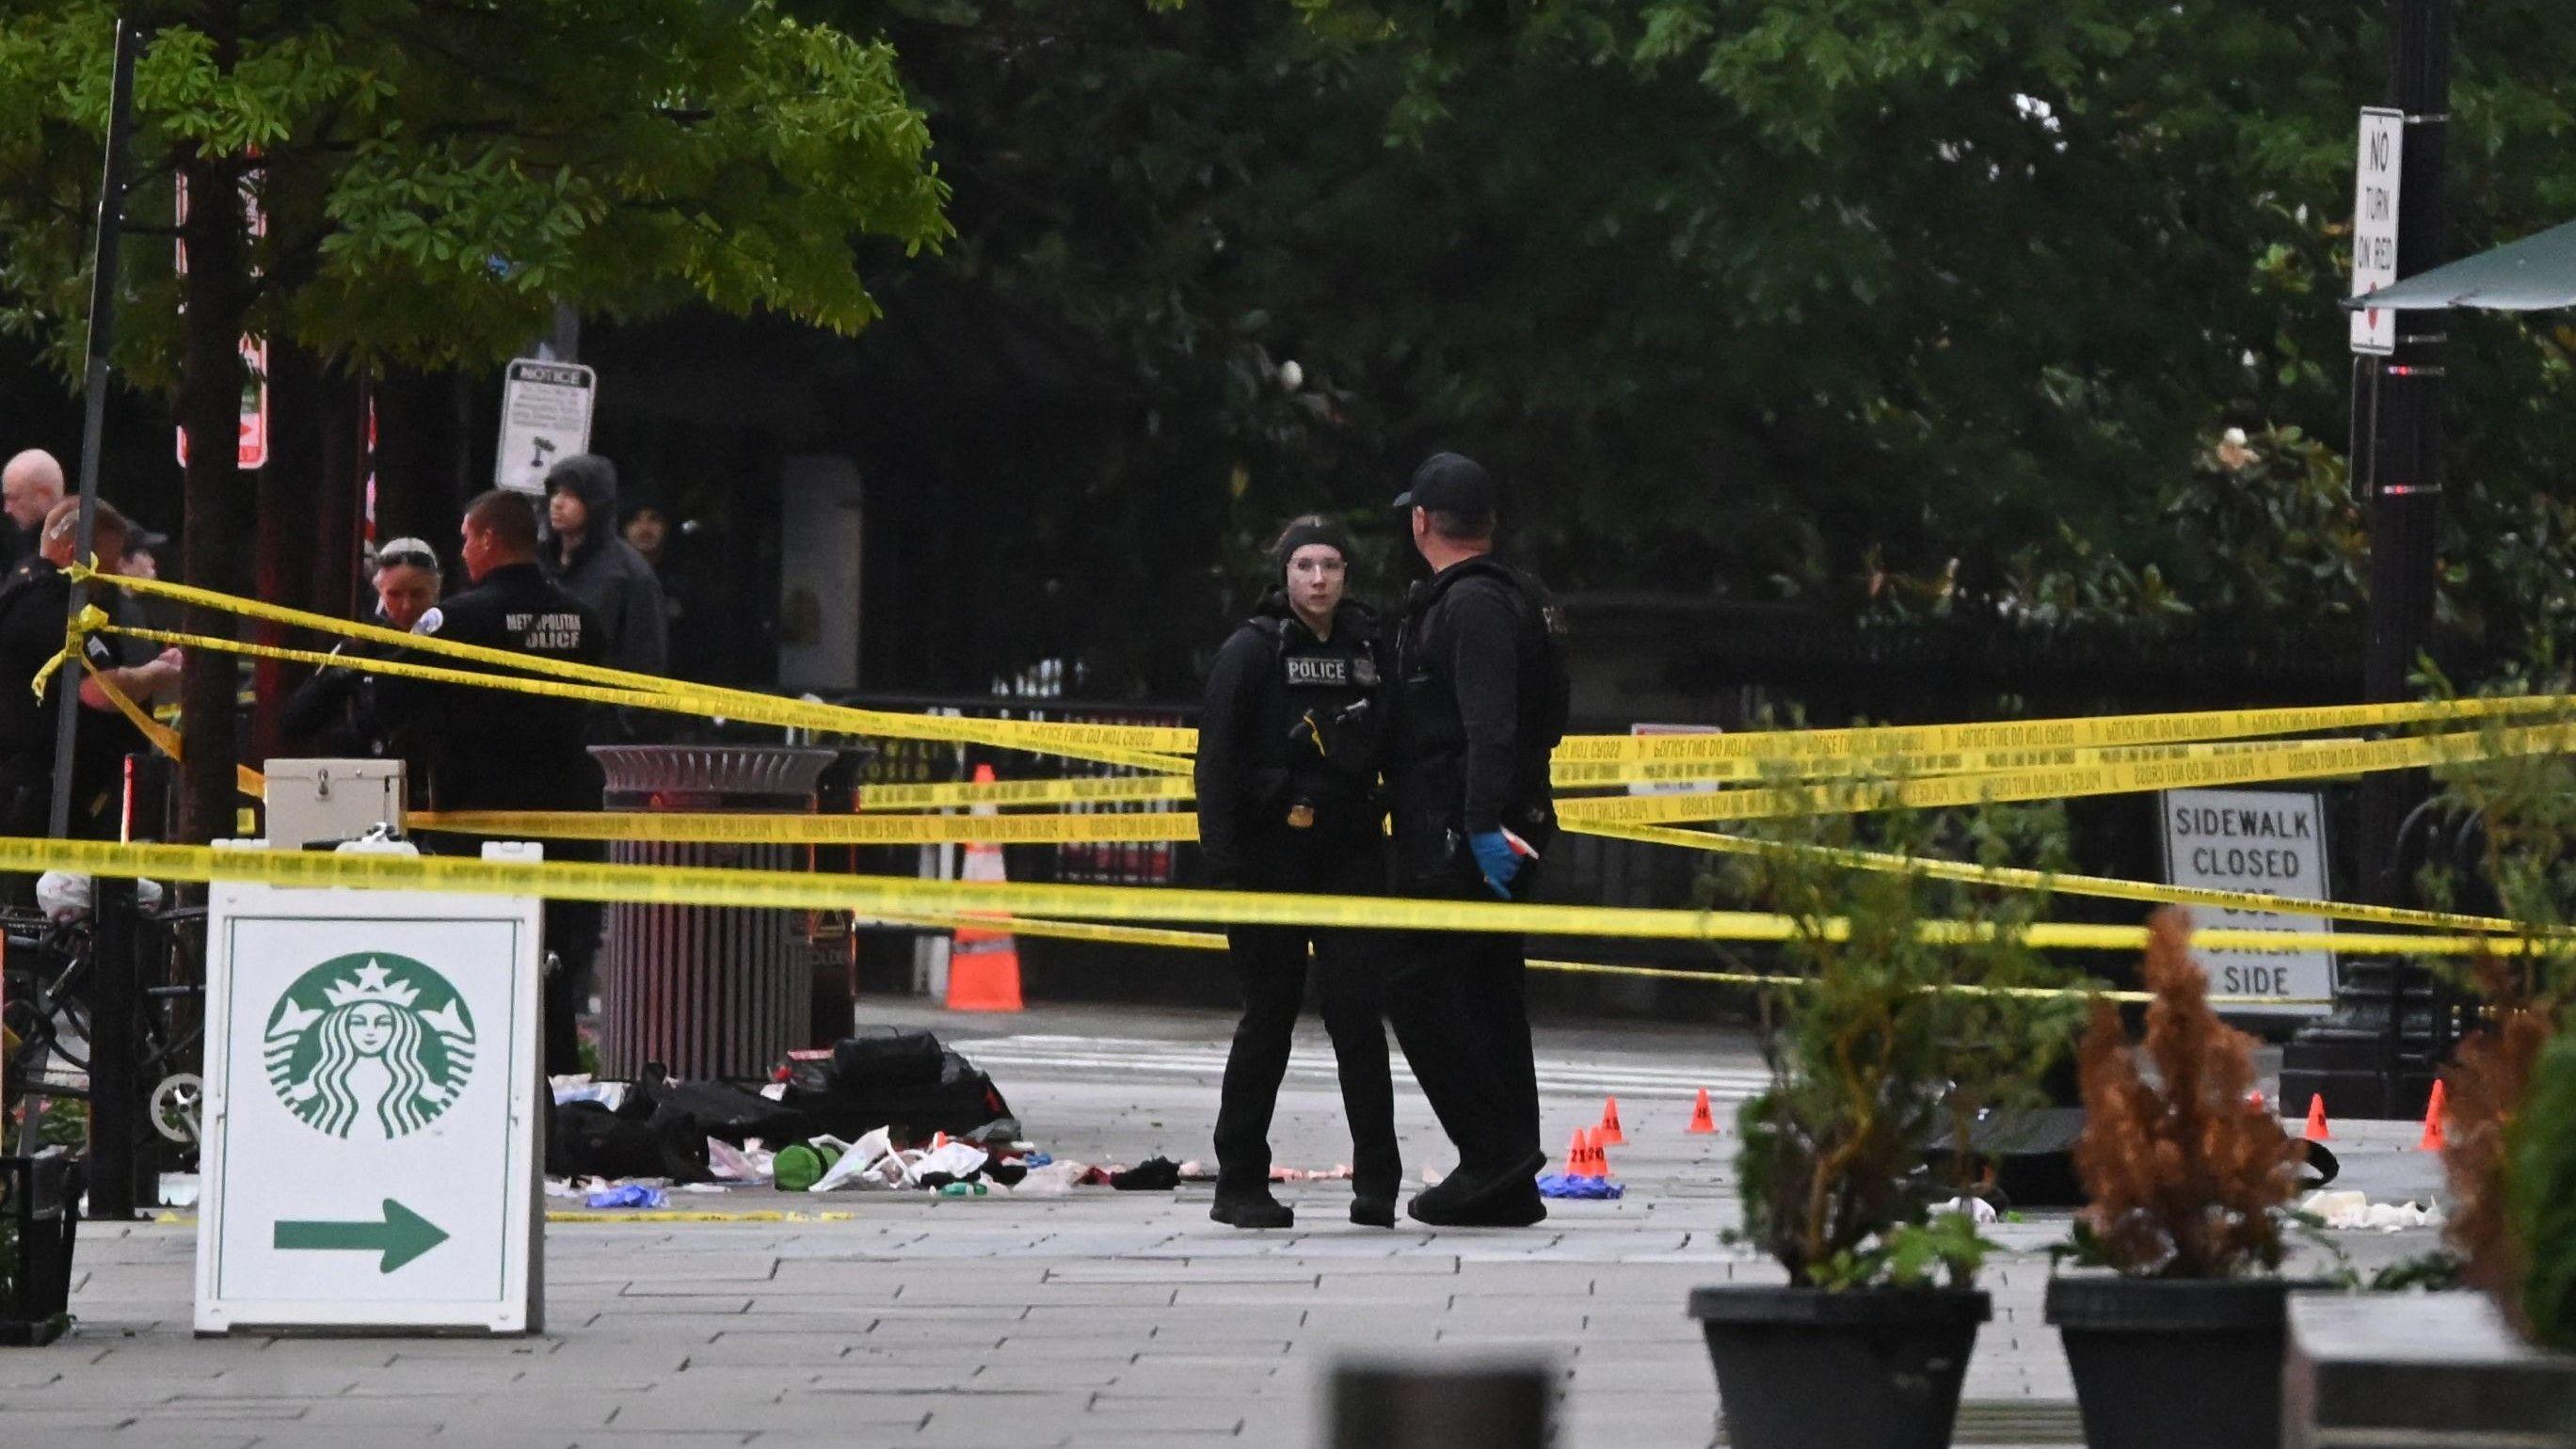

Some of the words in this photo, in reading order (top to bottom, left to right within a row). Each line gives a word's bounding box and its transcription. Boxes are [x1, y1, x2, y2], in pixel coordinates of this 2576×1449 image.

[2369, 131, 2390, 173] NO
[2358, 236, 2371, 269] ON
[2374, 237, 2393, 272] RED
[520, 366, 581, 386] NOTICE
[1288, 661, 1347, 680] POLICE
[2175, 807, 2312, 838] SIDEWALK
[2192, 848, 2299, 879] CLOSED
[2224, 965, 2290, 995] SIDE
